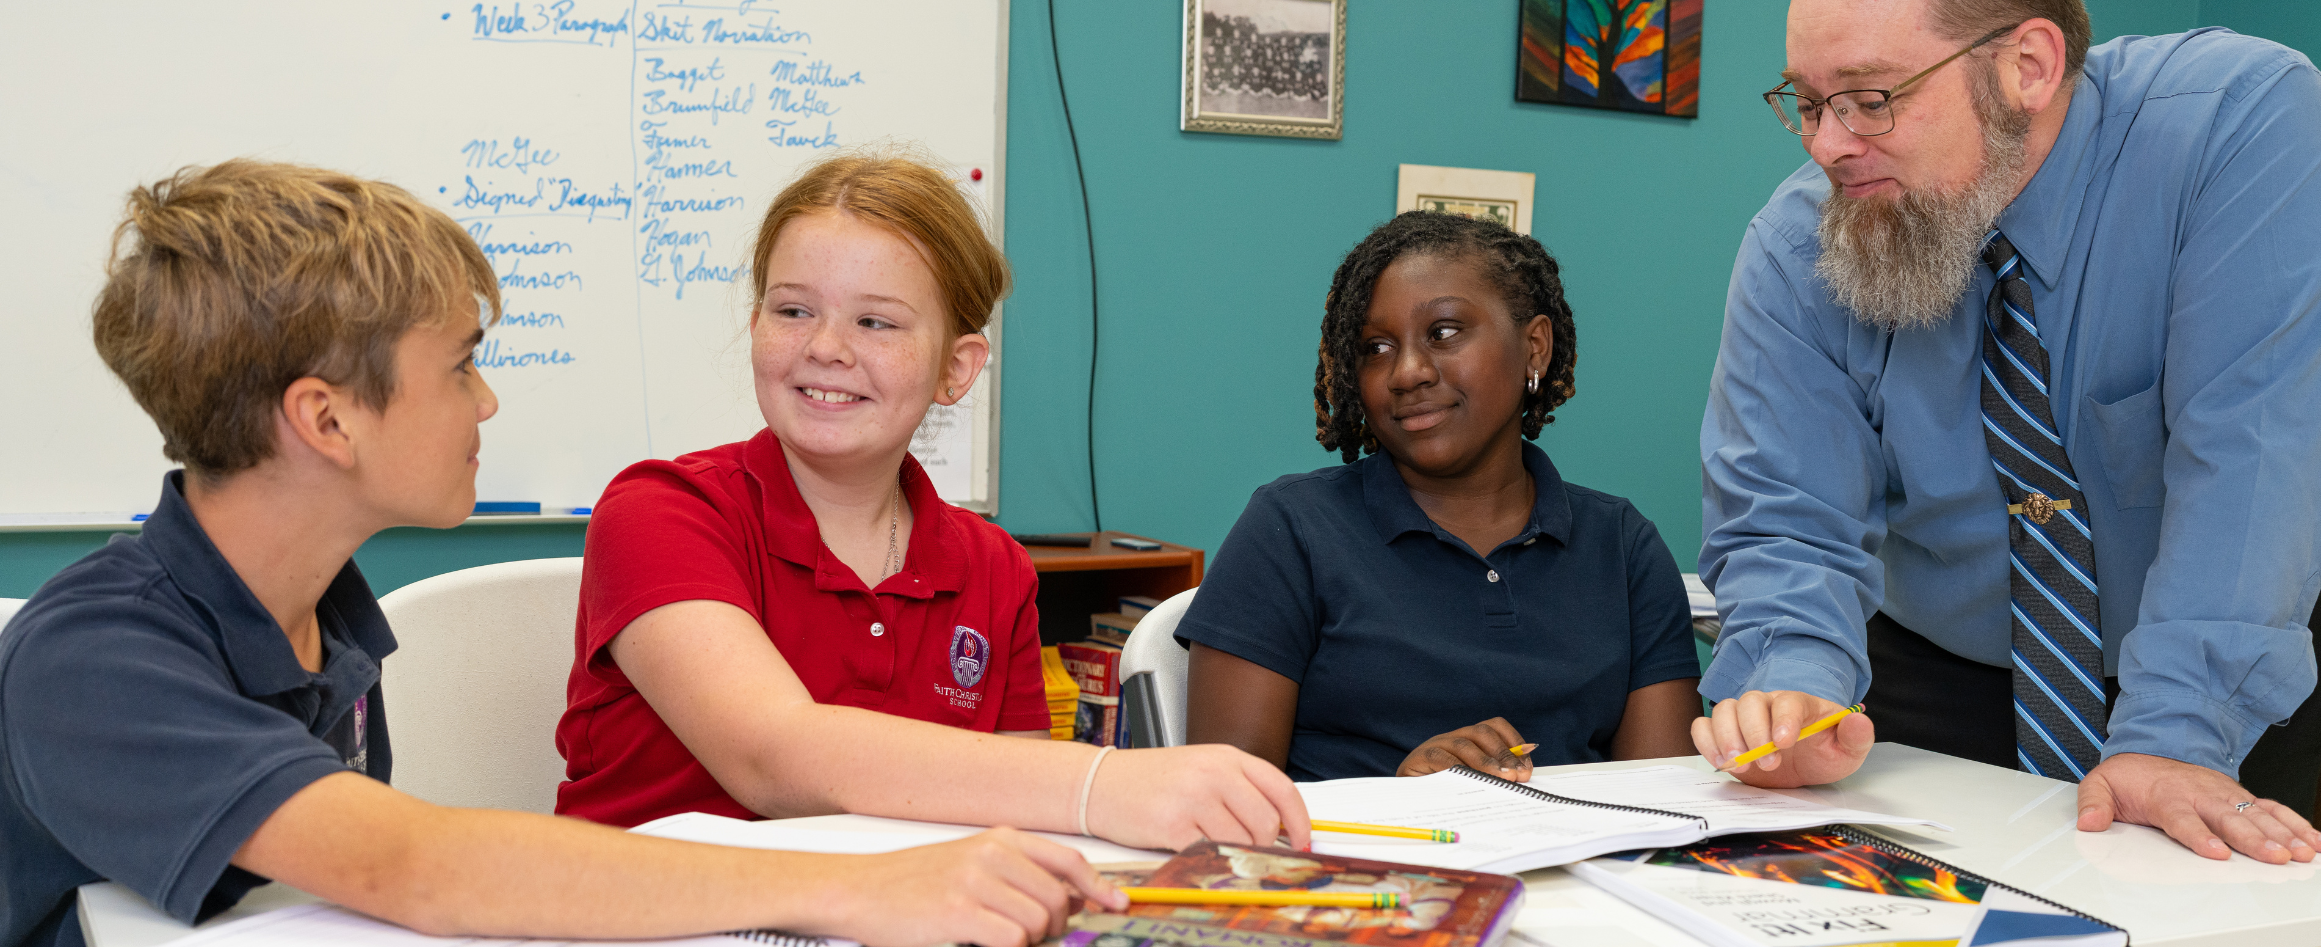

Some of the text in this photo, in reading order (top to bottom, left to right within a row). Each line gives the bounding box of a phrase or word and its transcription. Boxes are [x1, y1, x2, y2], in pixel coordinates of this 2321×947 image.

[471, 3, 529, 37] Week
[532, 4, 550, 32] 3
[550, 0, 630, 48] Paragraph
[461, 136, 560, 175] McGee
[485, 254, 582, 291] ohnson
[949, 697, 976, 710] SCHOOL
[1732, 902, 1932, 922] Grammar
